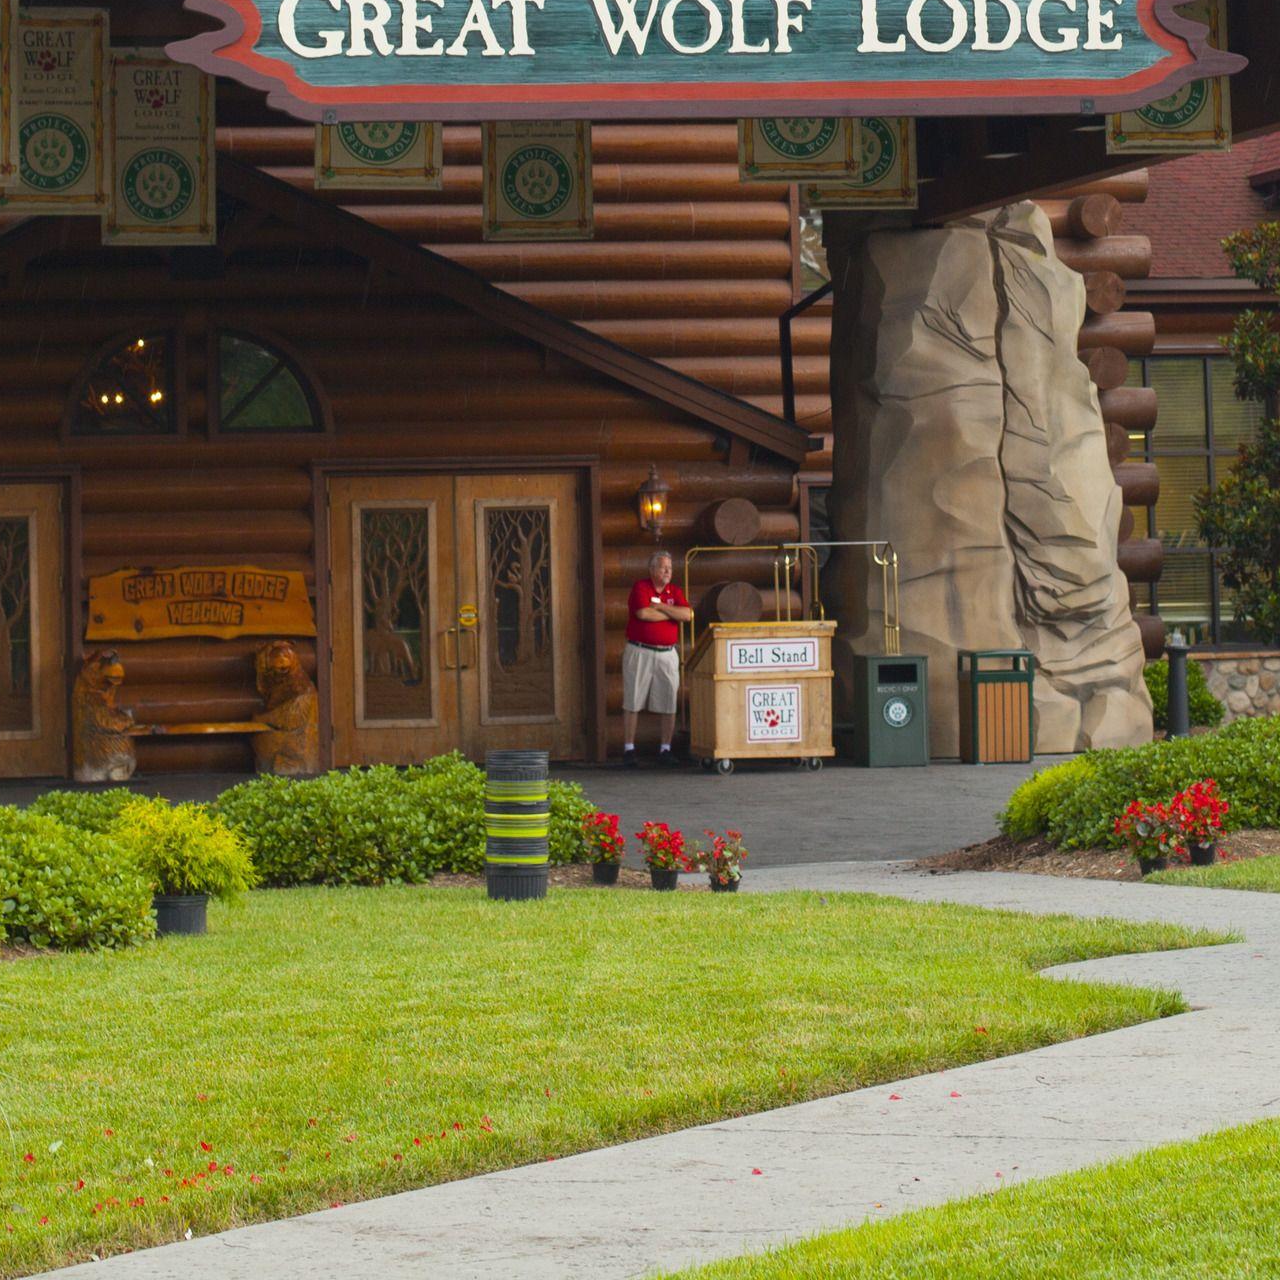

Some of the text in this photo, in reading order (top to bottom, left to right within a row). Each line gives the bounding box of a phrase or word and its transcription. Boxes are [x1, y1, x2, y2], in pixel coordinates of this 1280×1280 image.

[23, 31, 75, 48] GREAT
[133, 70, 182, 86] GREAT
[1174, 89, 1202, 122] WOLF
[23, 117, 78, 138] PROJECT
[765, 121, 796, 154] GREEN
[806, 123, 833, 153] WOLF
[343, 125, 413, 159] GREEN WOLF
[134, 152, 184, 171] PROJECT
[512, 150, 561, 168] PROJECT
[865, 150, 891, 181] WOLF
[56, 158, 84, 186] WOLF
[126, 186, 190, 218] GREEN WOLF
[505, 183, 568, 214] GREEN WOLF
[123, 573, 175, 601] GREAT
[233, 573, 288, 601] LODGE
[168, 601, 244, 624] WELCOME
[738, 645, 808, 664] Bell Stand
[752, 692, 795, 707] GREAT
[753, 728, 795, 736] LODGE
